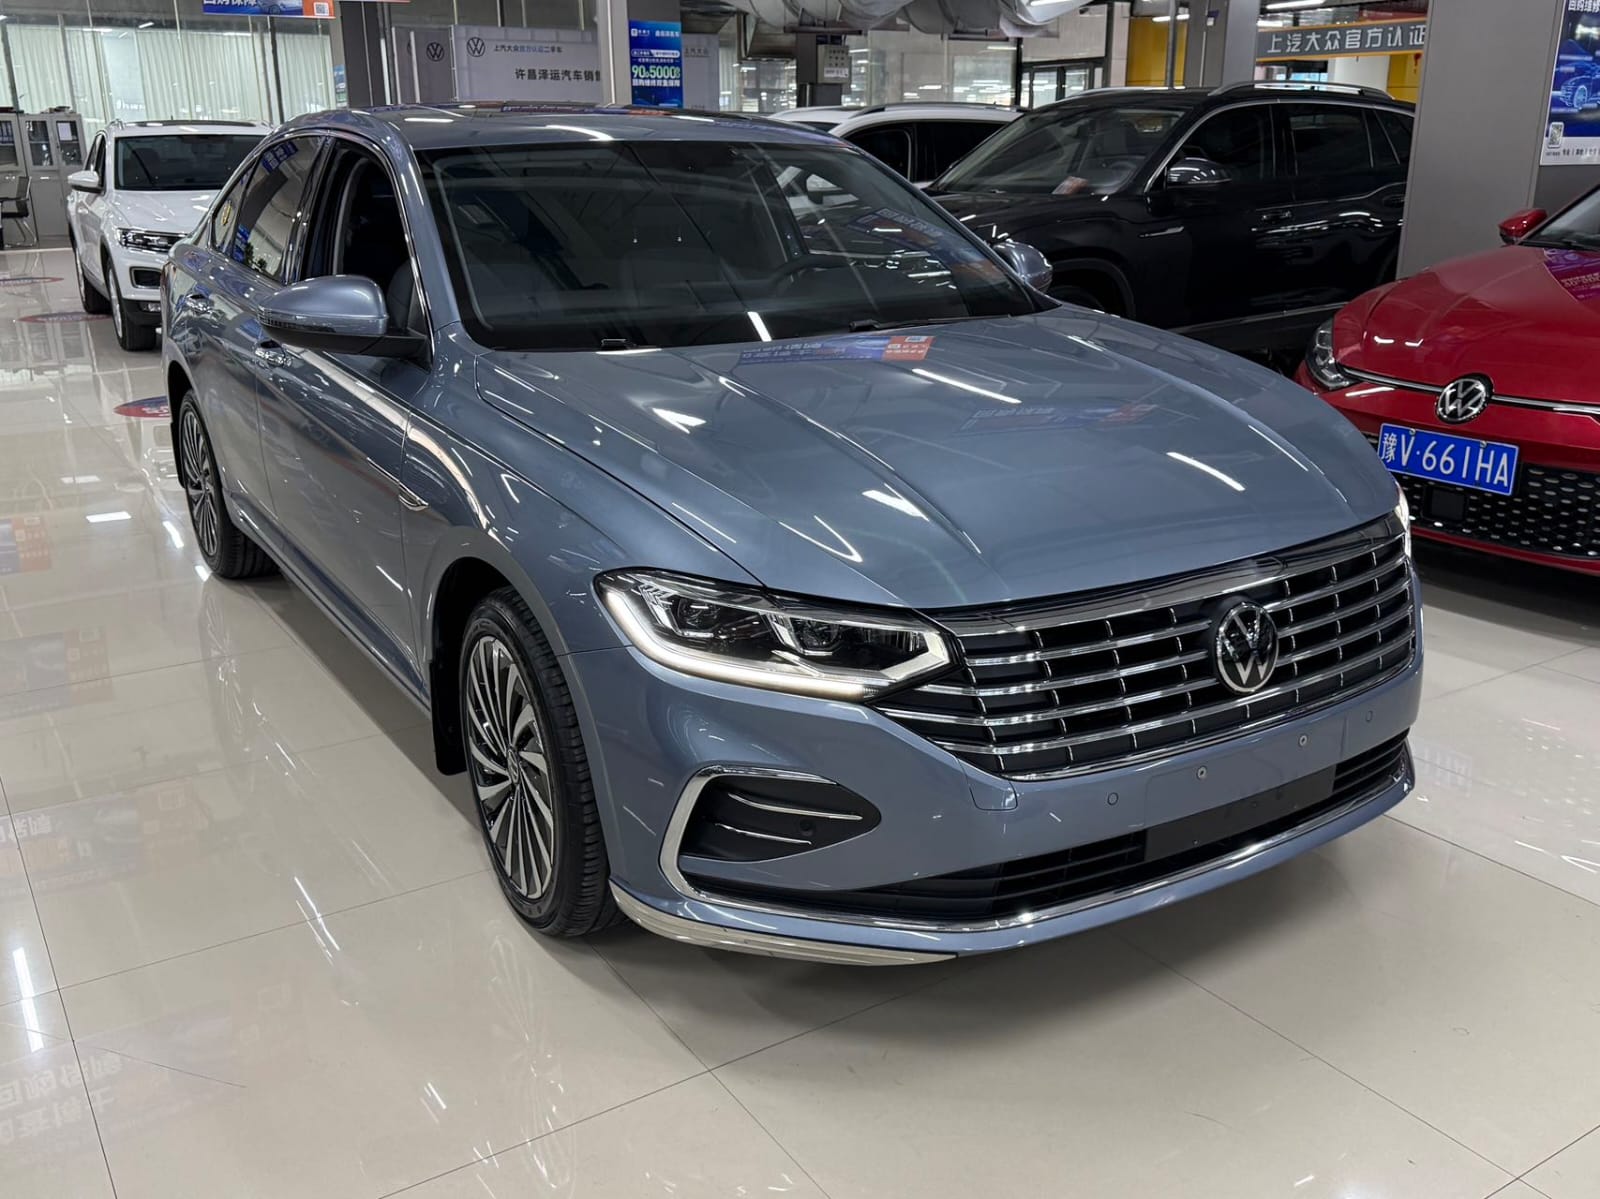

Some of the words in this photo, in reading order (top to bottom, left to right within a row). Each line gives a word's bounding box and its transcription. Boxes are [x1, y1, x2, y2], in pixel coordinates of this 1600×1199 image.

[1267, 25, 1426, 53] 上汽大众官方认证
